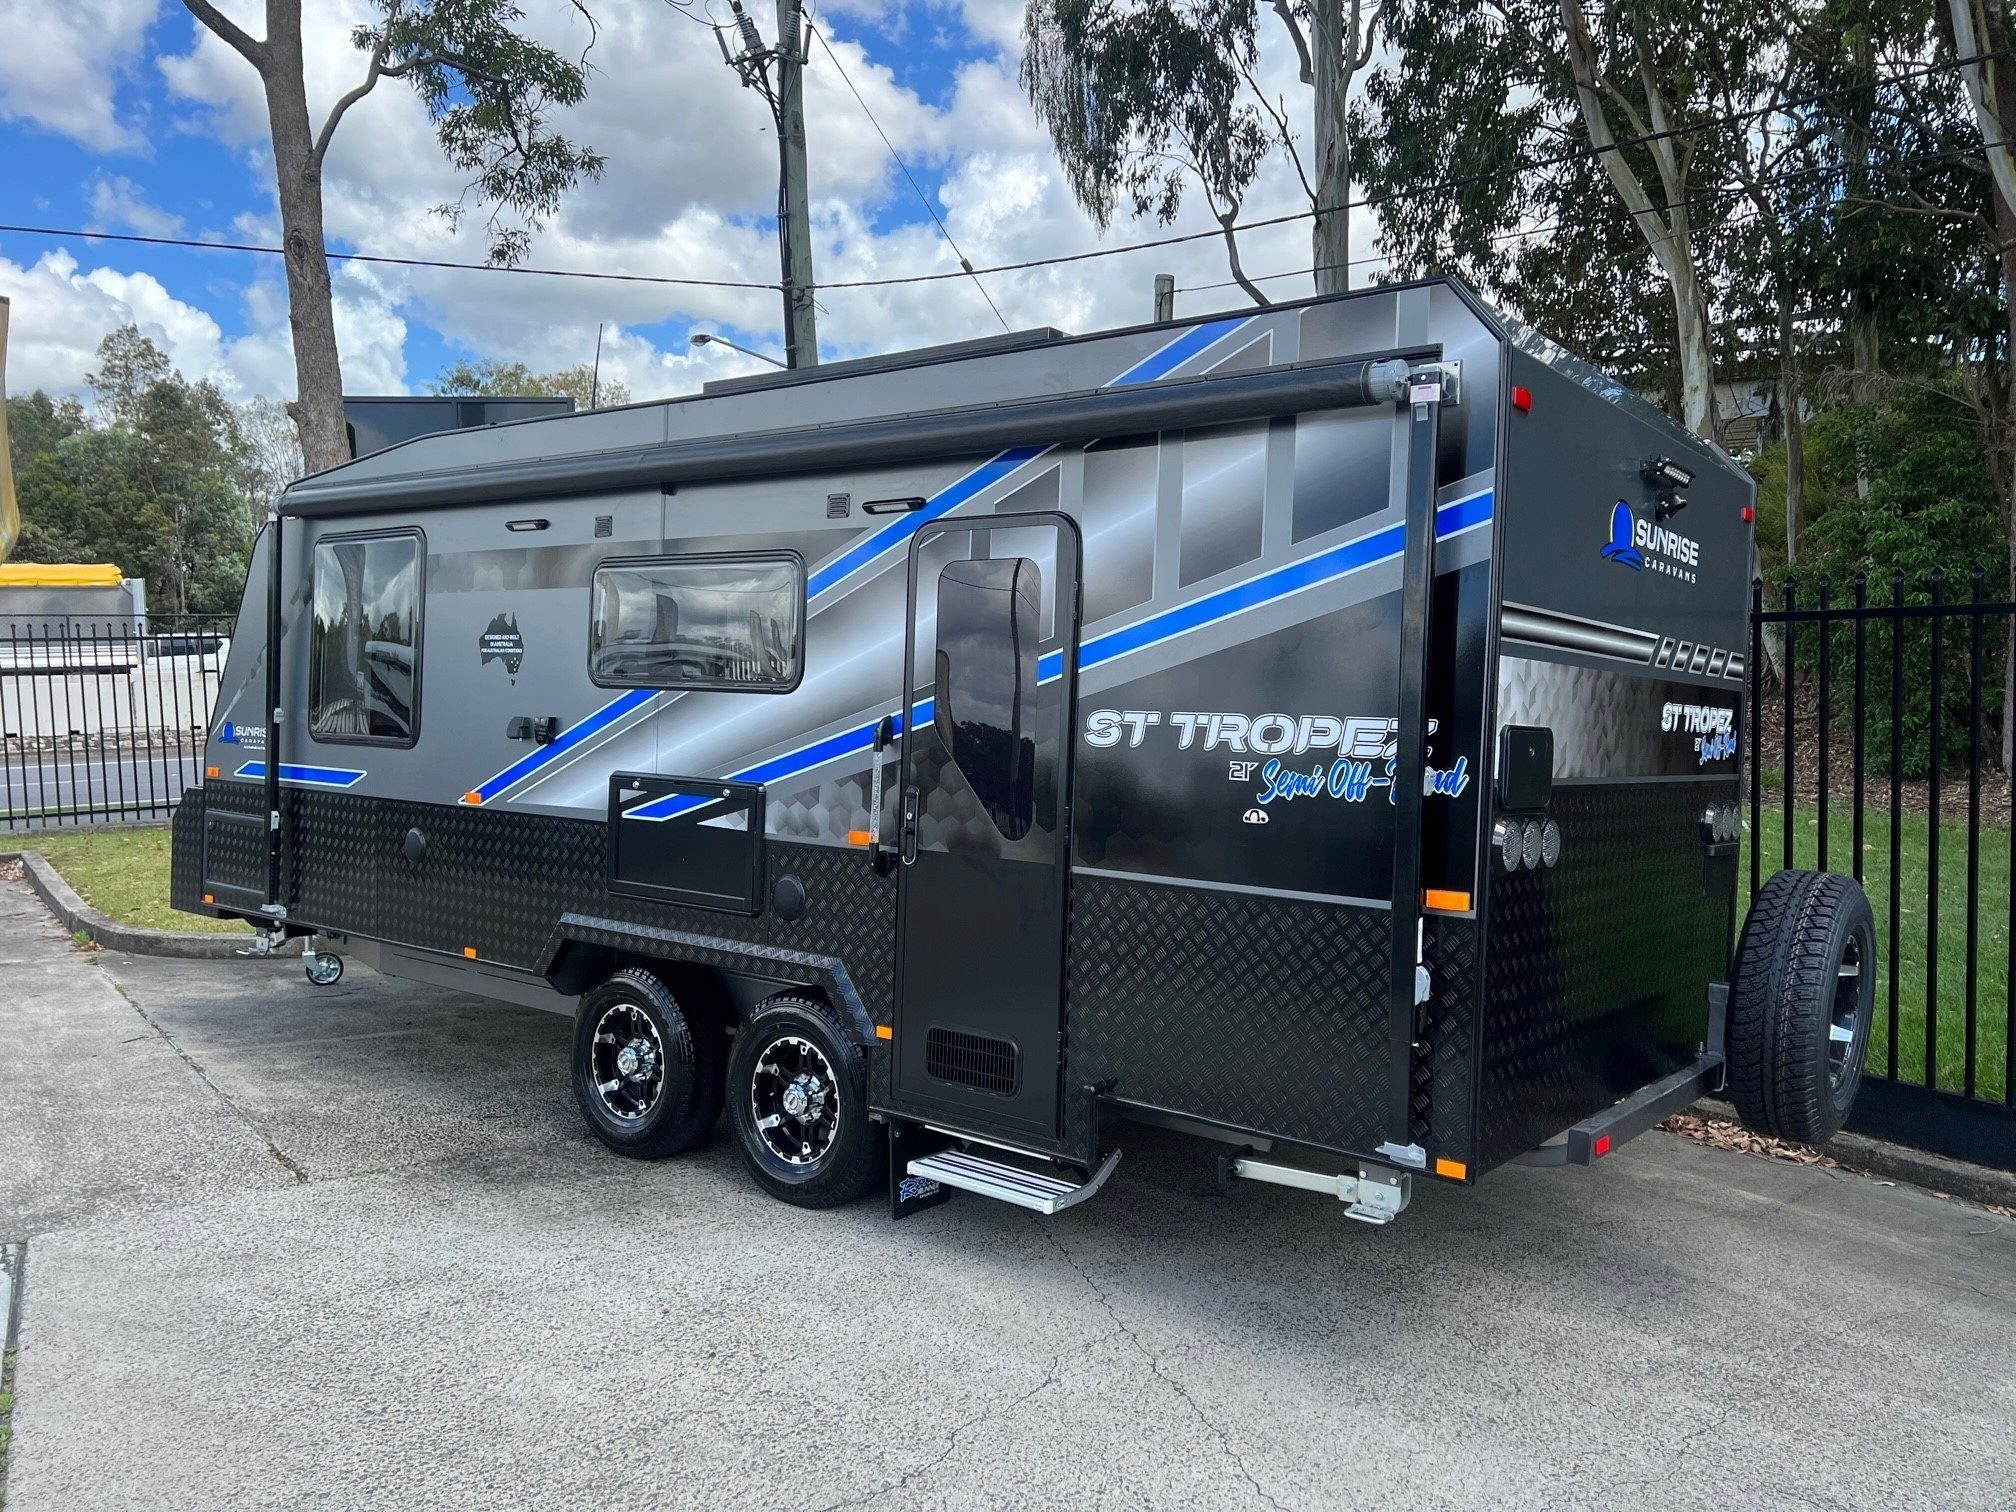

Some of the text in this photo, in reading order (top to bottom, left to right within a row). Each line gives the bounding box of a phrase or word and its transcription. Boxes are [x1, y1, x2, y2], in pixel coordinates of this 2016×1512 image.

[1635, 518, 1700, 567] SUNRISE
[1644, 556, 1697, 584] CARAVANS
[235, 725, 267, 738] SUNRIS
[1083, 708, 1162, 749] ST
[1661, 701, 1733, 734] ST TROPEZ
[1256, 757, 1326, 804] Semi
